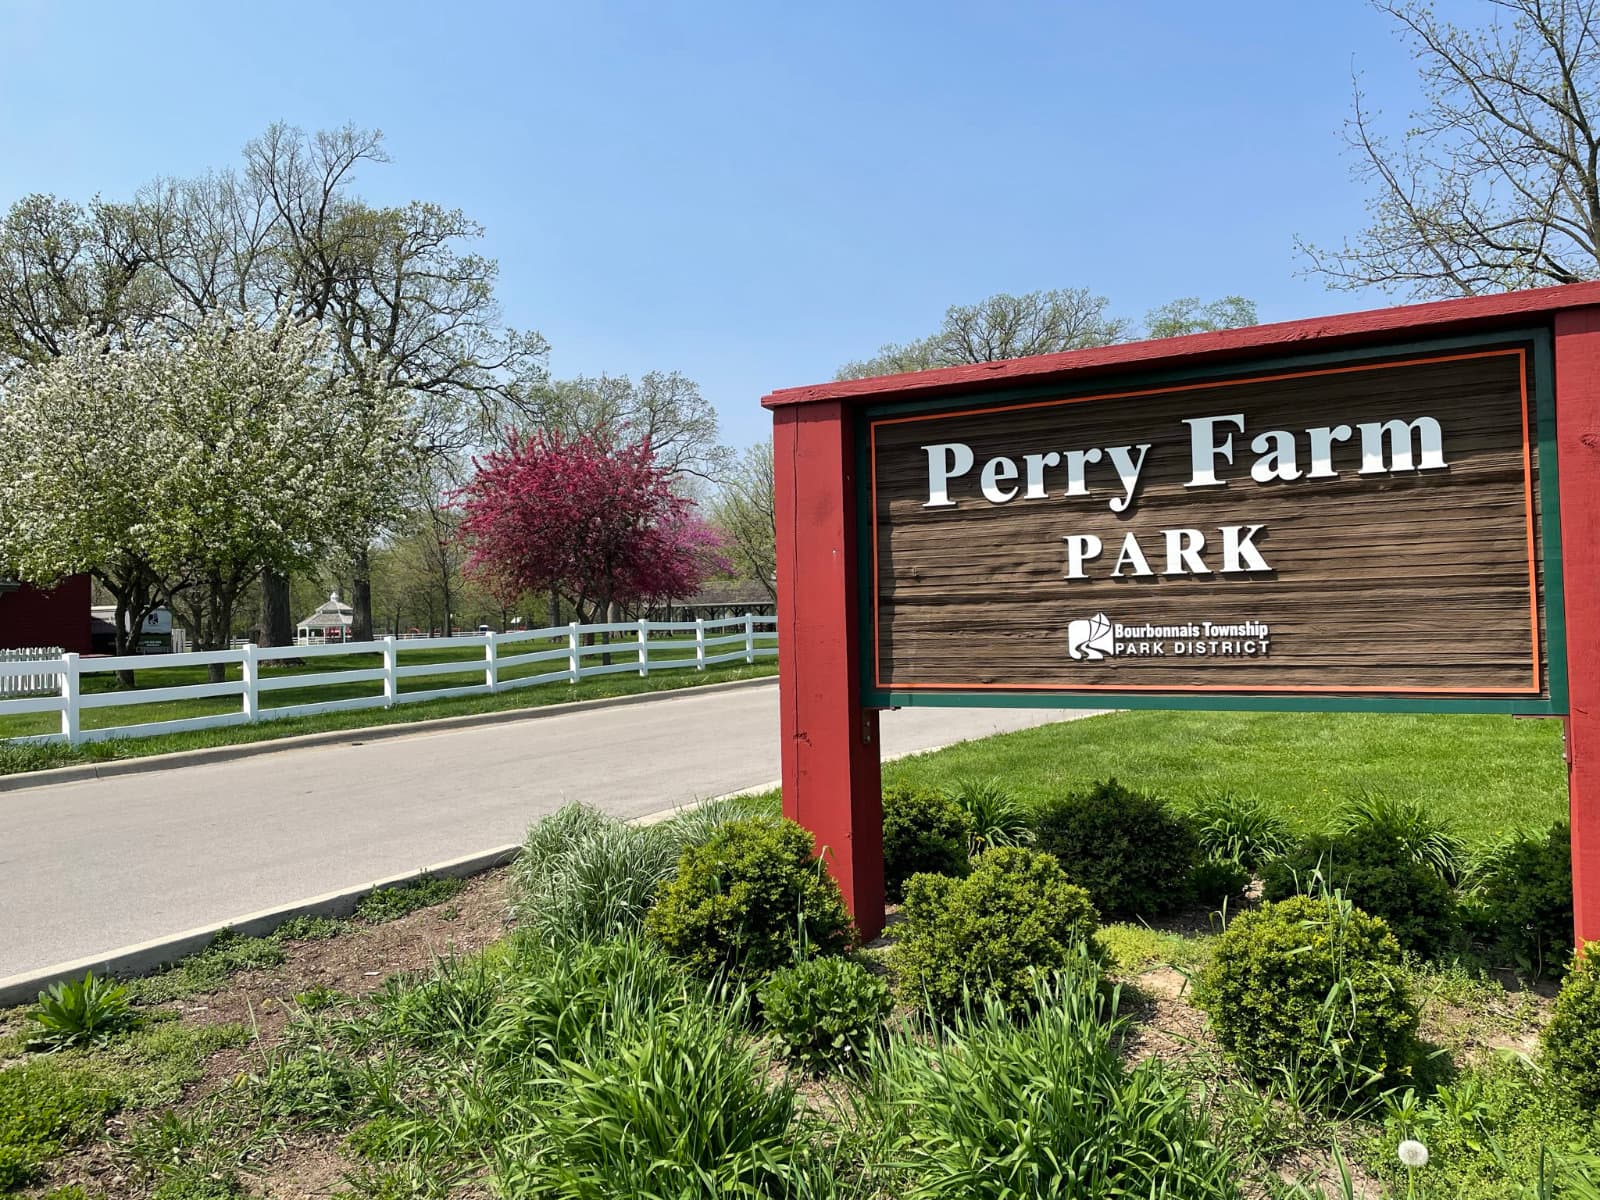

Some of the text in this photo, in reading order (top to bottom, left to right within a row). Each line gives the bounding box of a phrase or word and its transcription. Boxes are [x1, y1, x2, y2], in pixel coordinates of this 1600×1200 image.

[921, 413, 1448, 512] Perry Farm
[1062, 524, 1272, 579] PARK
[1114, 620, 1268, 639] Bourbonnais Township
[1115, 640, 1270, 655] PARK DISTRICT
